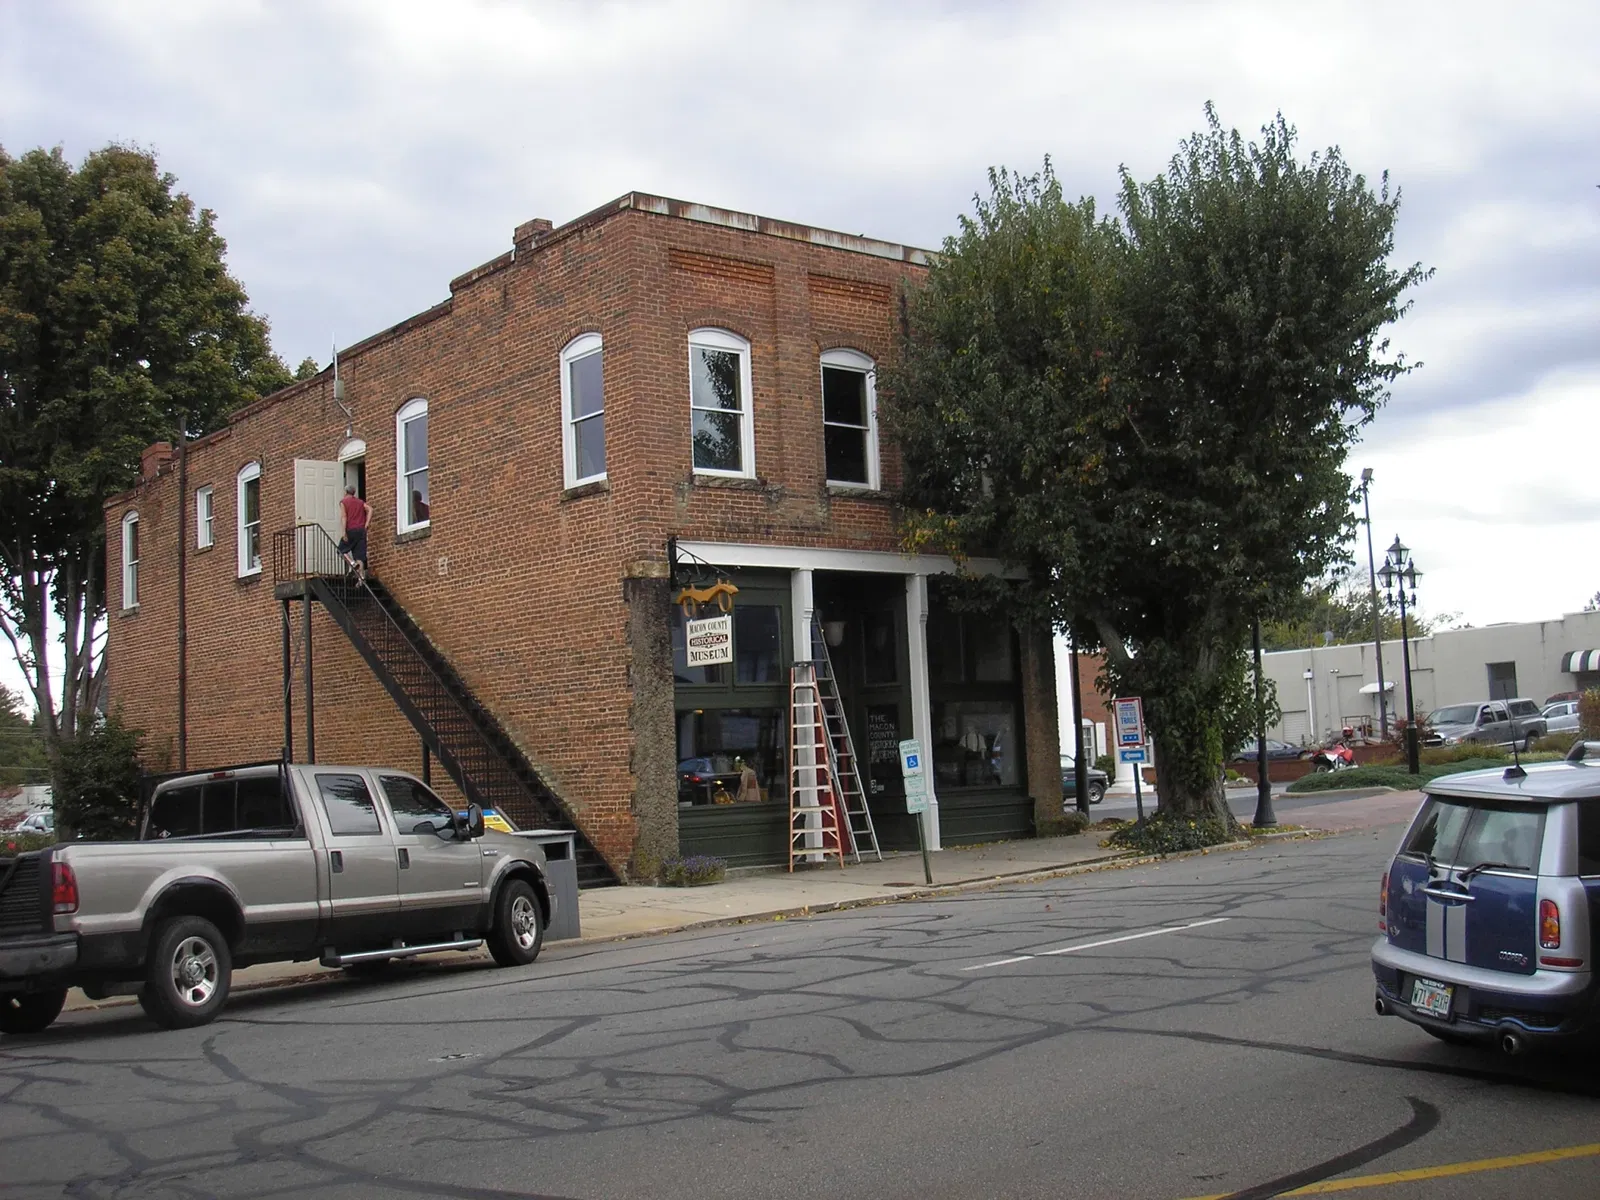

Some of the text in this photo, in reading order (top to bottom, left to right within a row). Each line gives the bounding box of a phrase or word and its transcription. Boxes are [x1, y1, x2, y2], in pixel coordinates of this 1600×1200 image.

[689, 621, 728, 635] MACON COUNTY
[690, 636, 727, 646] HISTORICAL
[690, 647, 729, 662] MUSEUM
[869, 731, 895, 739] COUNTY
[1498, 950, 1528, 965] COOPER S
